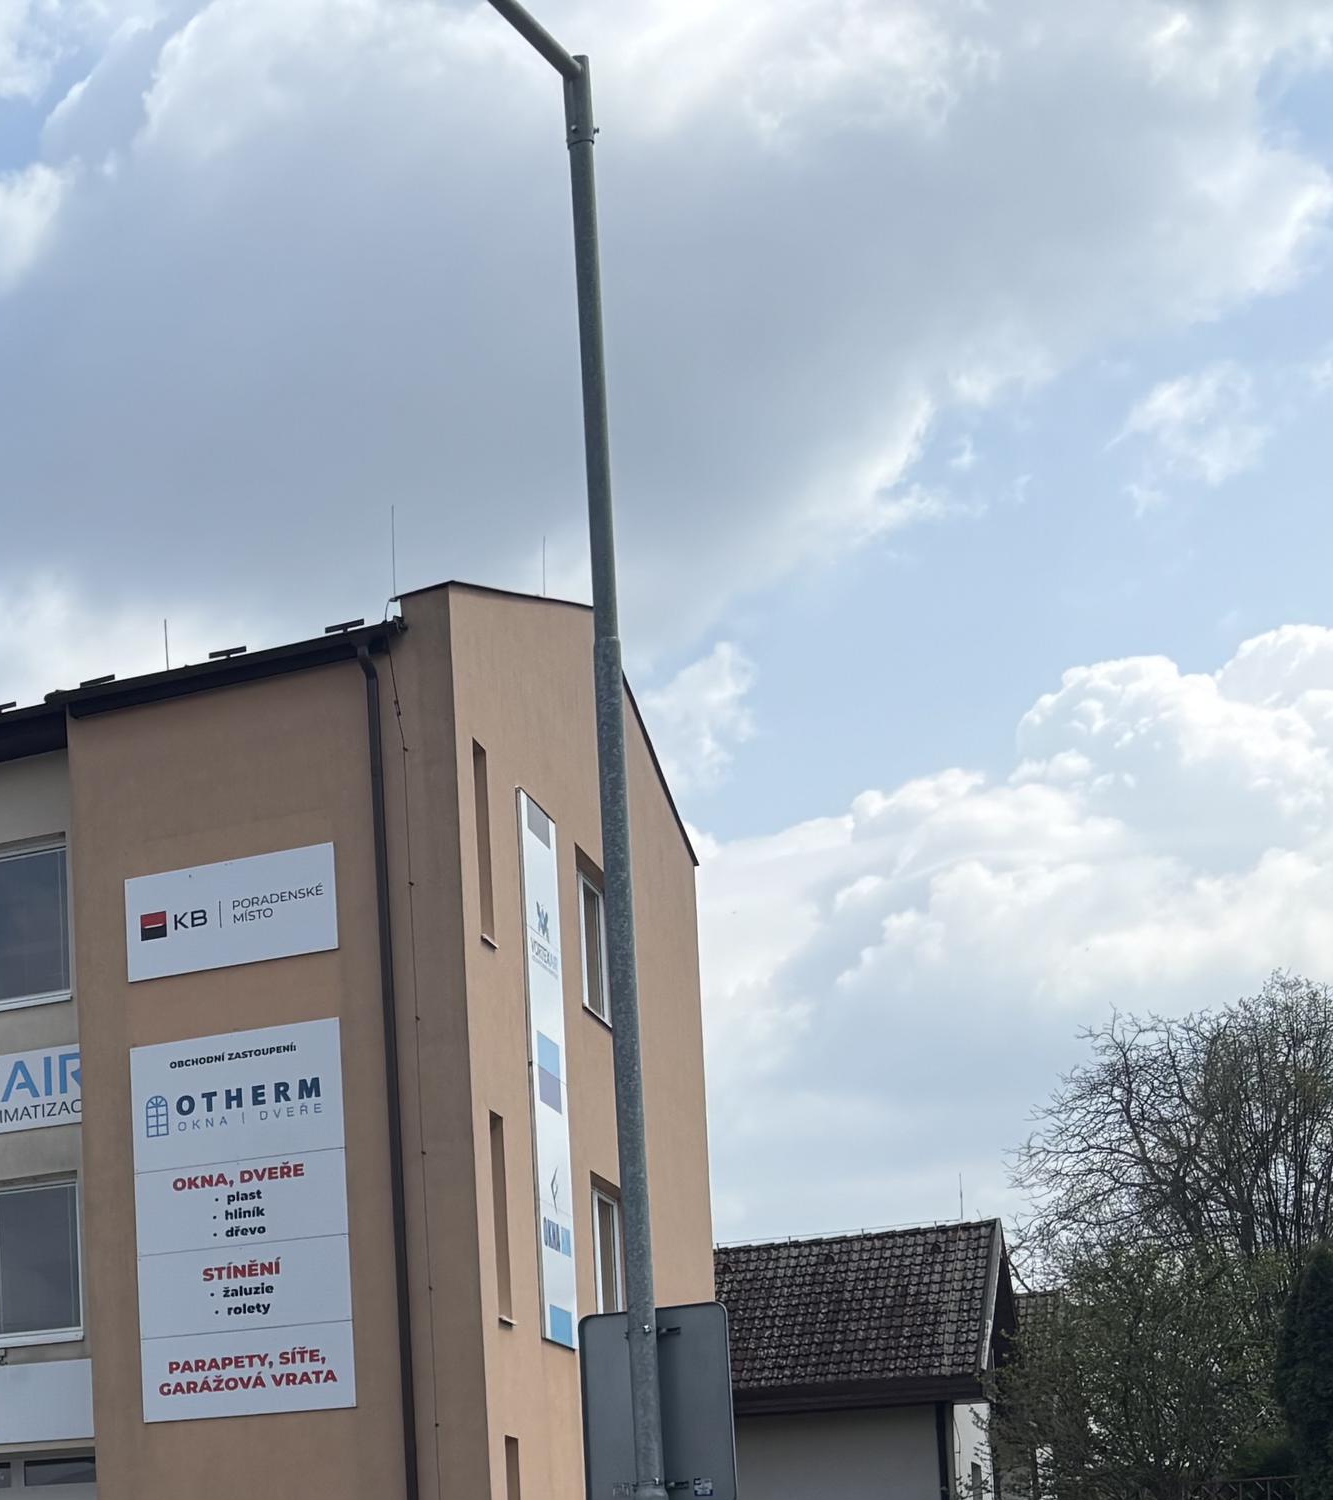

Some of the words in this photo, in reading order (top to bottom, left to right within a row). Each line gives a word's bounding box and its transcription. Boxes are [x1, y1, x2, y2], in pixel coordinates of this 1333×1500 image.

[174, 909, 208, 931] KB
[232, 884, 324, 910] PORADENSKÉ
[233, 907, 274, 924] MÍSTO
[169, 1052, 225, 1069] OBCHODNÍ
[228, 1041, 297, 1061] ZASTOUPENÍ:
[175, 1076, 322, 1116] OTHERM
[177, 1116, 228, 1132] OKNA
[260, 1103, 323, 1121] DVEŘE
[172, 1172, 235, 1192] OKNA,
[239, 1161, 305, 1184] DVEŘE
[227, 1189, 262, 1205] plast
[225, 1206, 265, 1220] hliník
[225, 1225, 266, 1238] dřevo
[202, 1256, 281, 1282] STÍNĚNÍ
[222, 1282, 274, 1298] žaluzie
[227, 1303, 271, 1316] rolety
[168, 1353, 274, 1375] PARAPETY,
[158, 1371, 266, 1397] GARÁŽOVÁ
[271, 1369, 338, 1388] VRATA
